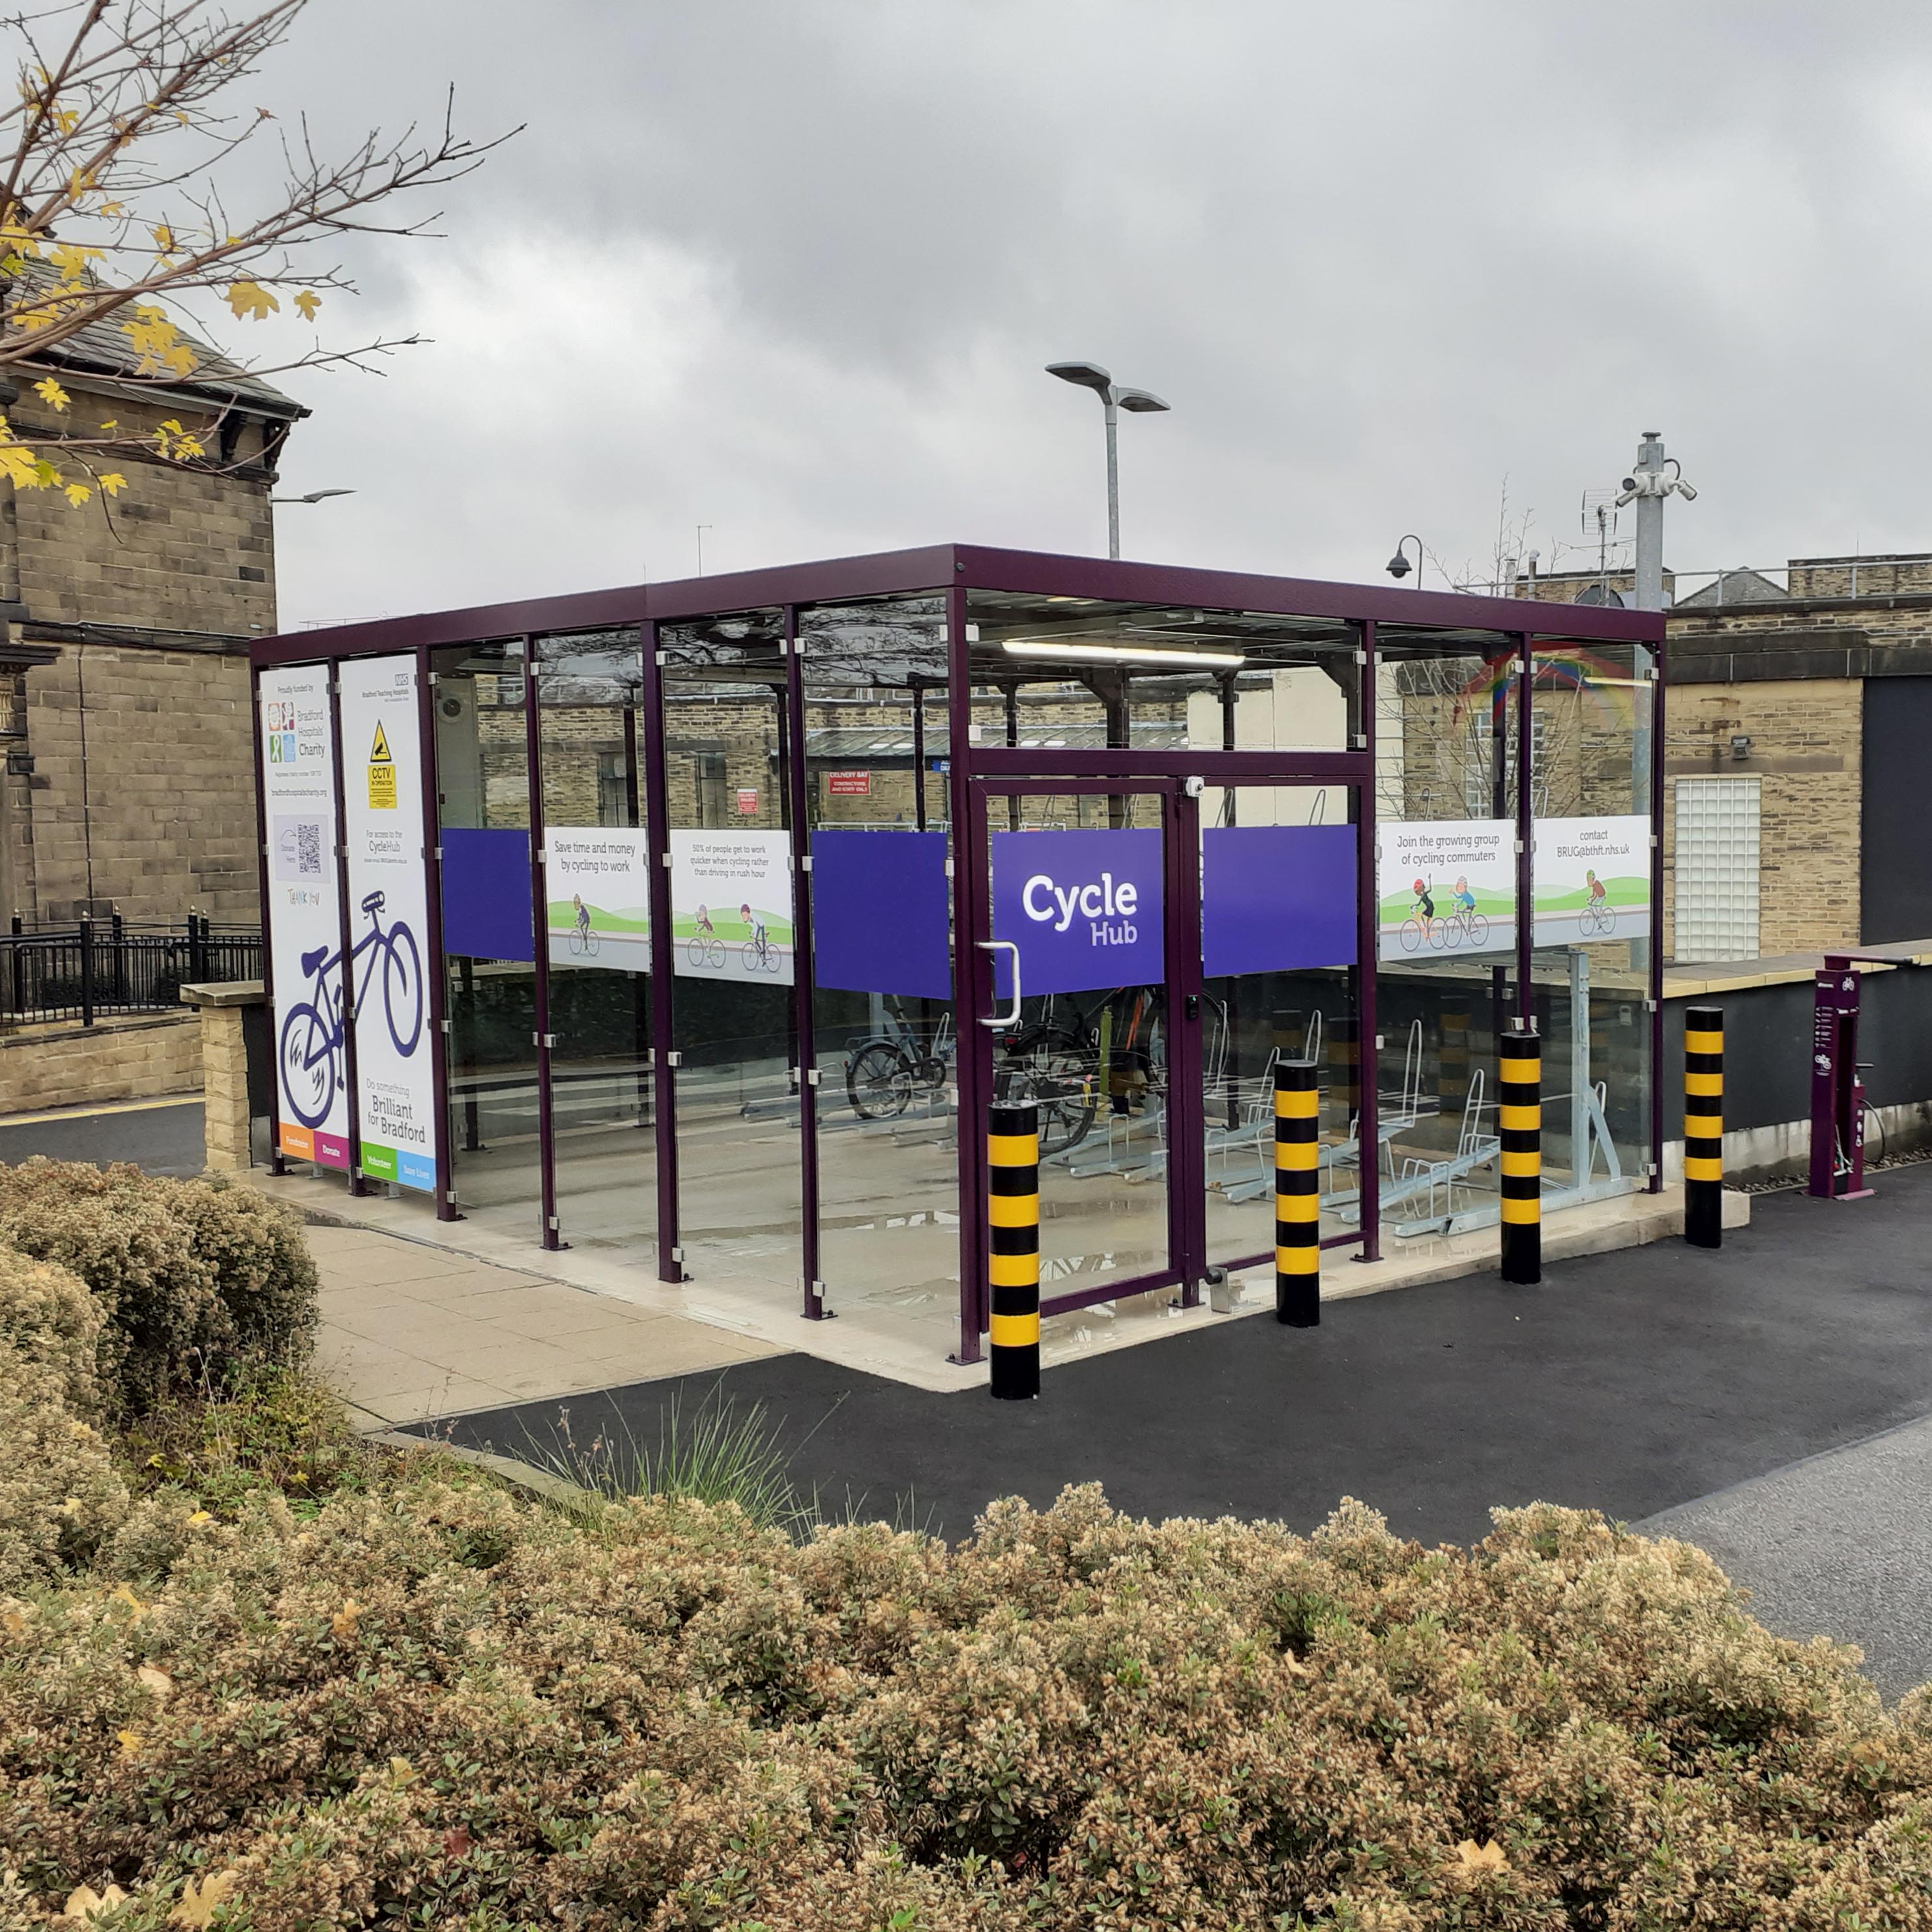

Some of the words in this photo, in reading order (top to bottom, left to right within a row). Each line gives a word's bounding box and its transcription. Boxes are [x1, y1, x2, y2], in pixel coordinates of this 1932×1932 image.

[395, 673, 408, 686] NHS
[293, 684, 308, 693] funded
[308, 684, 314, 694] by
[297, 709, 324, 722] Bradford
[299, 743, 325, 759] Charity
[372, 767, 390, 779] CCTV
[1397, 836, 1417, 847] Join
[1419, 834, 1434, 847] the
[1436, 834, 1472, 849] growing
[1474, 835, 1500, 848] group
[1579, 830, 1608, 841] contact
[369, 840, 401, 855] CycleHub
[555, 840, 572, 853] Save
[573, 840, 590, 853] time
[591, 842, 607, 854] and
[608, 845, 636, 858] money
[692, 844, 704, 853] 50%
[705, 844, 711, 853] of
[712, 845, 732, 855] people
[733, 846, 742, 855] get
[751, 845, 766, 854] work
[1557, 843, 1630, 858] BRUG@bthft.nhs.uk
[561, 858, 571, 873] by
[572, 858, 599, 874] cycling
[600, 860, 609, 871] to
[609, 860, 630, 872] work
[690, 856, 711, 866] quicker
[712, 856, 728, 865] when
[729, 856, 750, 868] cycling
[751, 857, 769, 866] rather
[1401, 853, 1411, 864] of
[1412, 851, 1444, 867] cycling
[1446, 851, 1496, 862] commuters
[694, 868, 708, 876] than
[709, 868, 729, 879] driving
[729, 868, 735, 877] in
[737, 869, 750, 877] rush
[751, 869, 765, 878] hour
[287, 888, 308, 905] THANK
[309, 890, 320, 906] YOU
[1022, 872, 1138, 932] Cycle
[1090, 920, 1138, 946] Hub
[366, 1077, 375, 1089] Do
[376, 1081, 410, 1099] something
[372, 1094, 413, 1120] Brilliant
[368, 1111, 379, 1126] for
[381, 1117, 426, 1144] Bradford
[322, 1144, 341, 1158] Donate
[366, 1154, 392, 1169] Volunteer
[403, 1164, 416, 1177] Save
[416, 1167, 430, 1180] Lives
